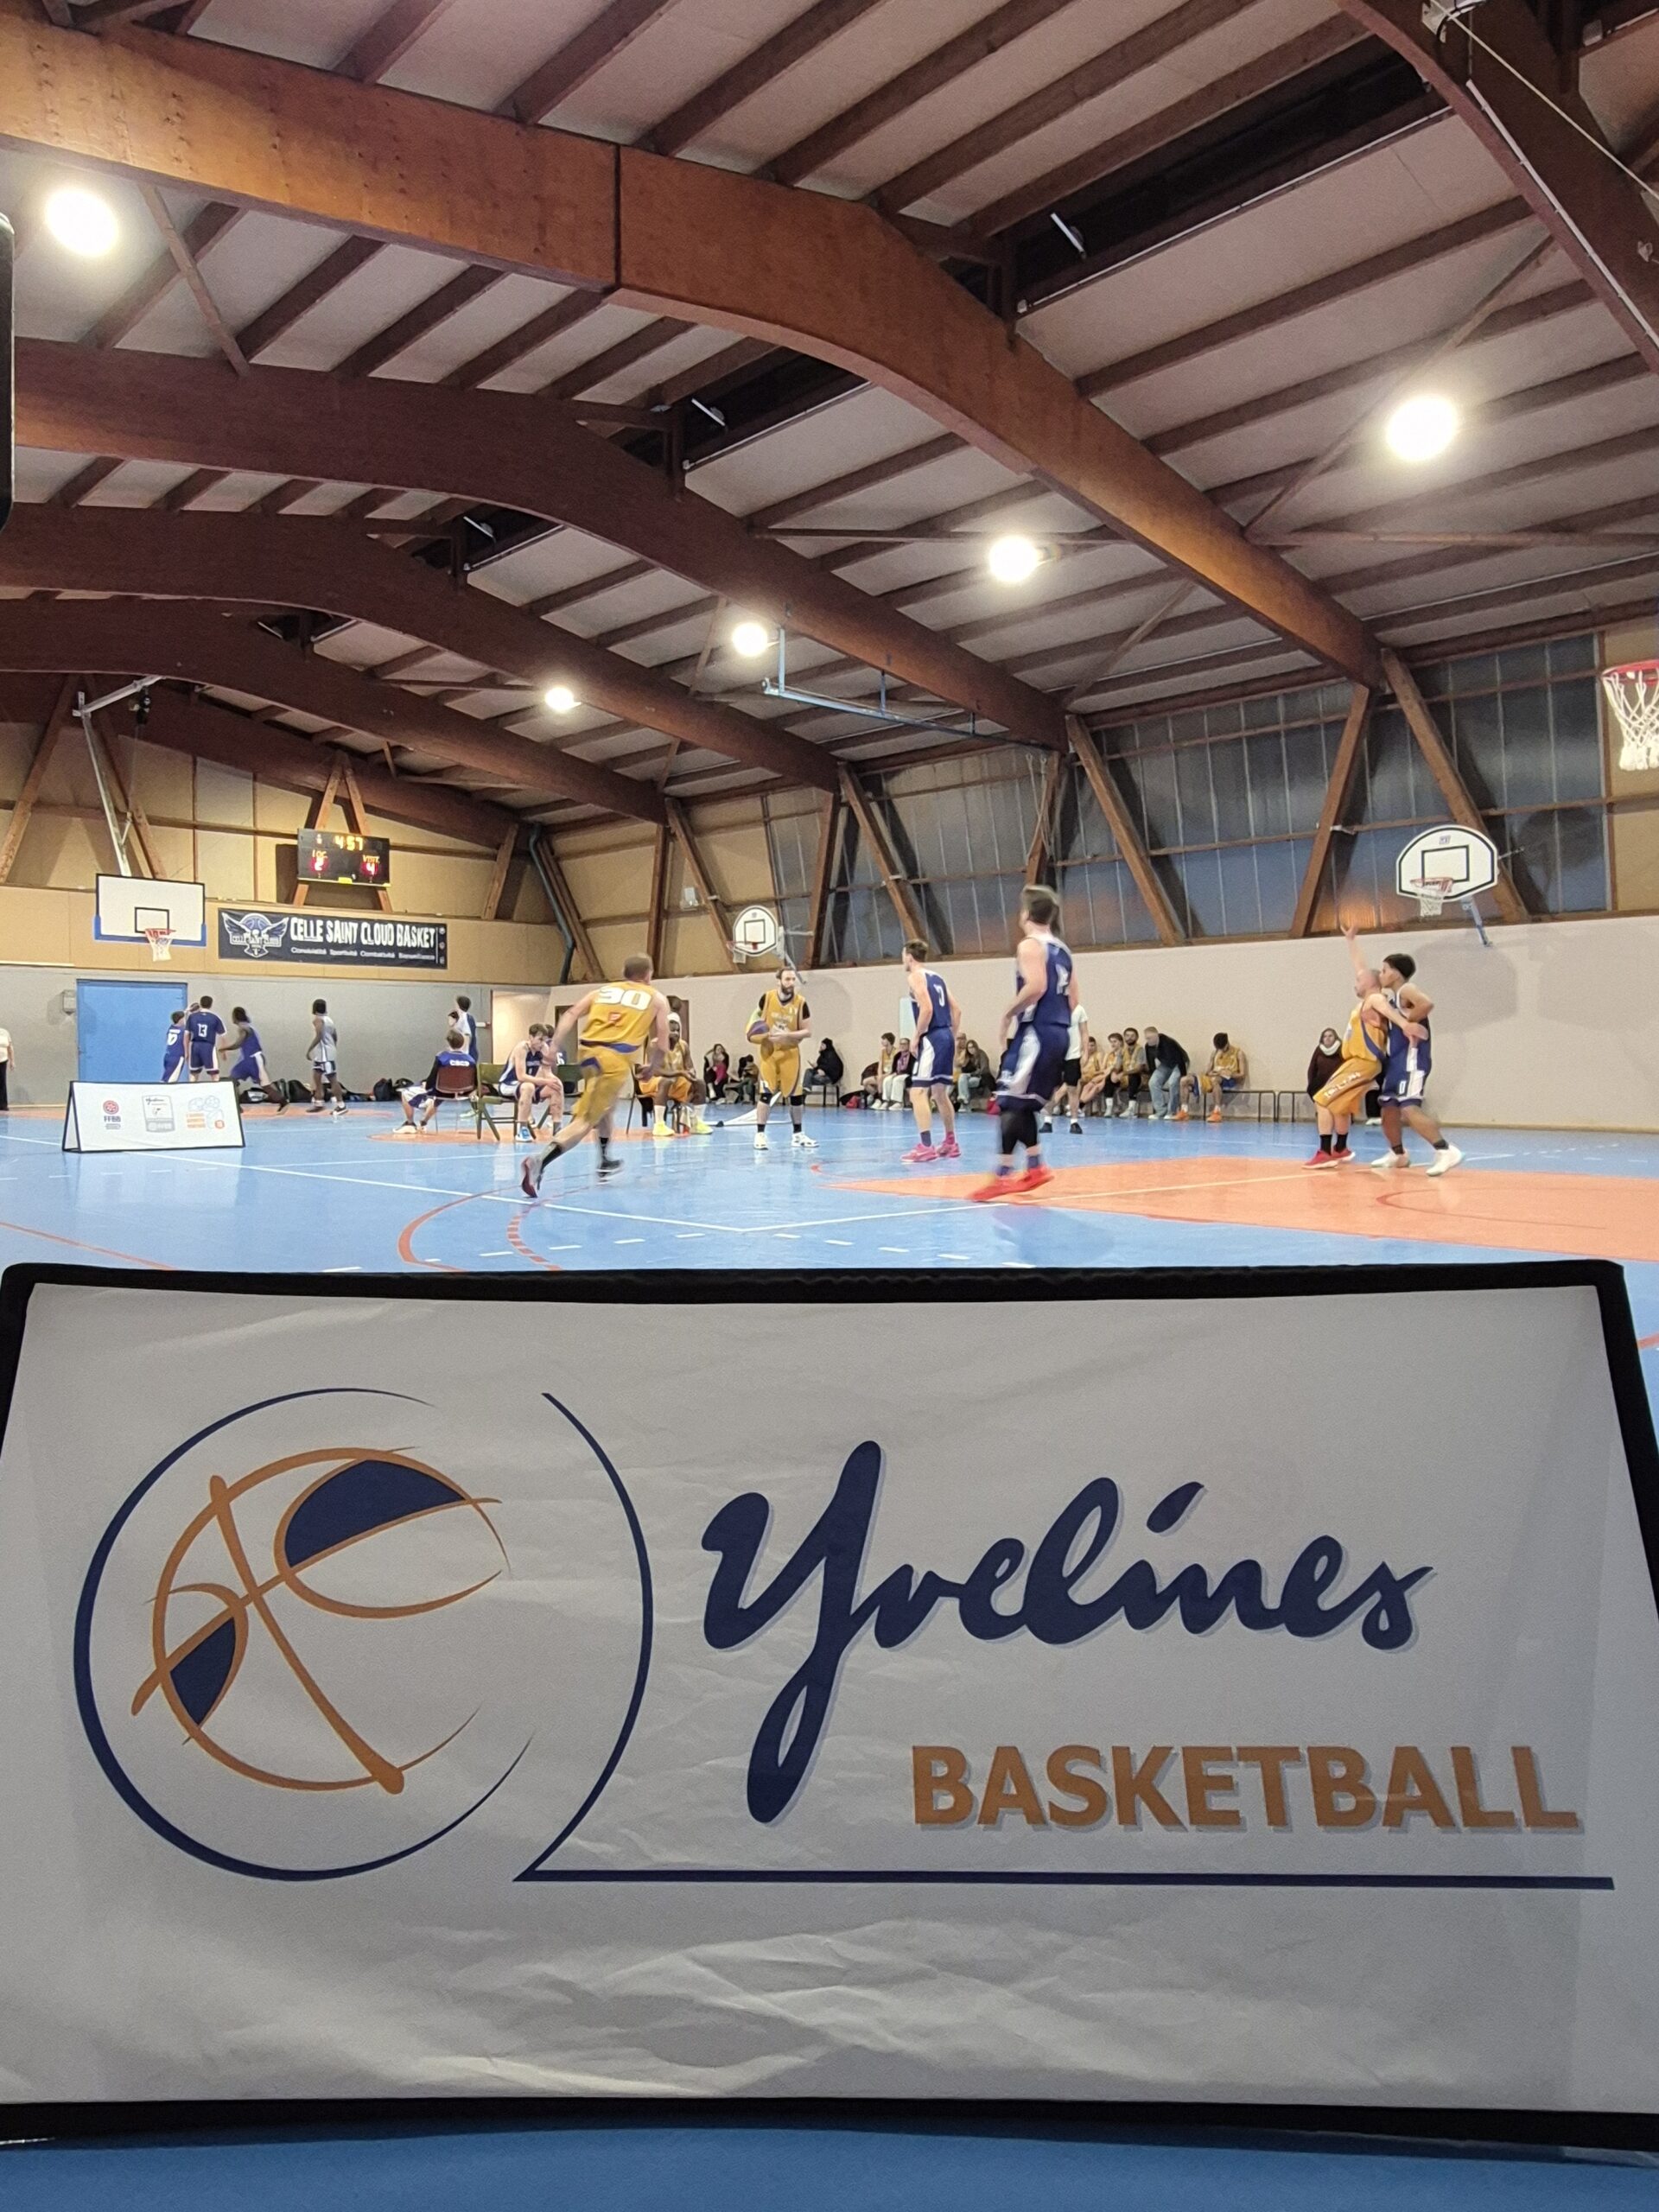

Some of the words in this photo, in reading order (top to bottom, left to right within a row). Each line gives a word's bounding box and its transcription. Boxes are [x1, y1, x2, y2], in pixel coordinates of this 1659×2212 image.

[290, 917, 324, 943] CELLE
[326, 919, 359, 945] SAINT
[360, 921, 394, 947] CLOUD
[397, 923, 435, 949] BASKET
[701, 1440, 1434, 1825] Yvelines
[912, 1746, 1581, 1832] BASKETBALL
